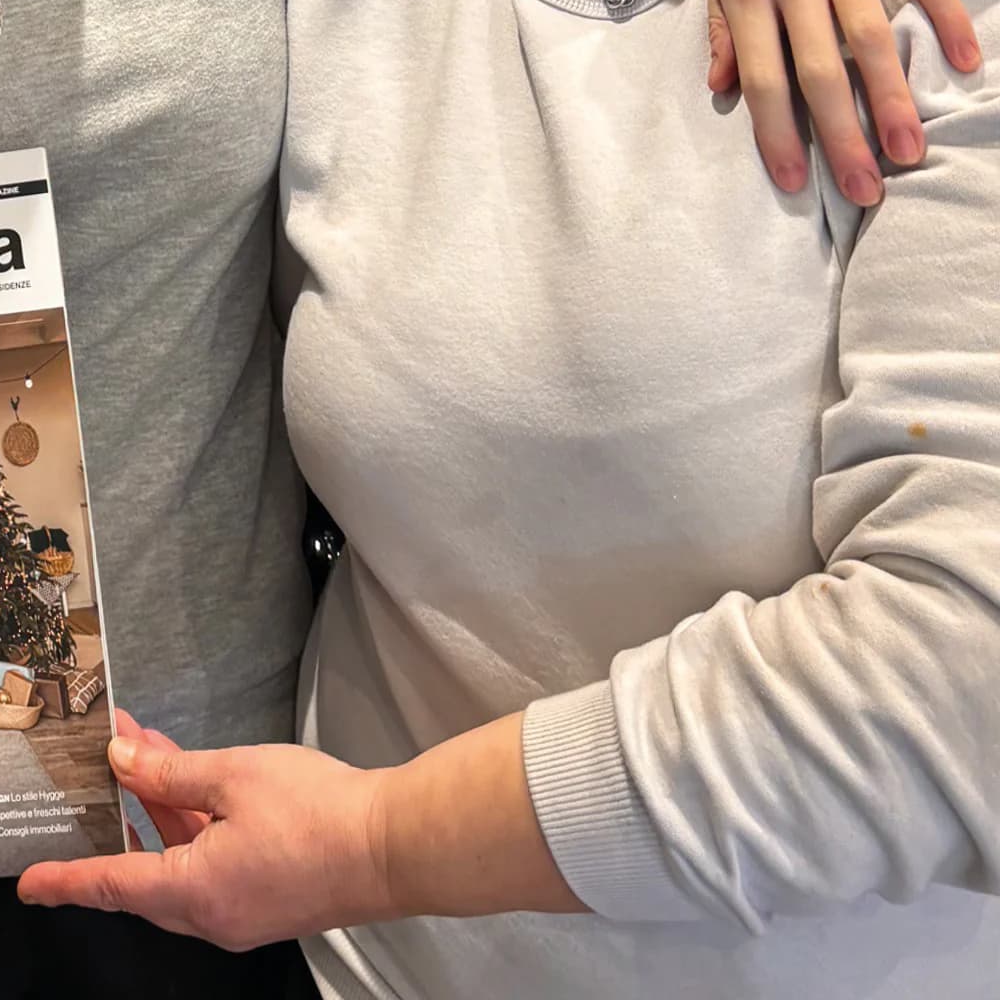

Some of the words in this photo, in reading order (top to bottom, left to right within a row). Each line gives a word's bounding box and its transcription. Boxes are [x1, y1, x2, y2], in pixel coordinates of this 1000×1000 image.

[11, 792, 21, 802] Lo
[34, 806, 60, 818] freschi
[30, 822, 73, 834] immobiliari
